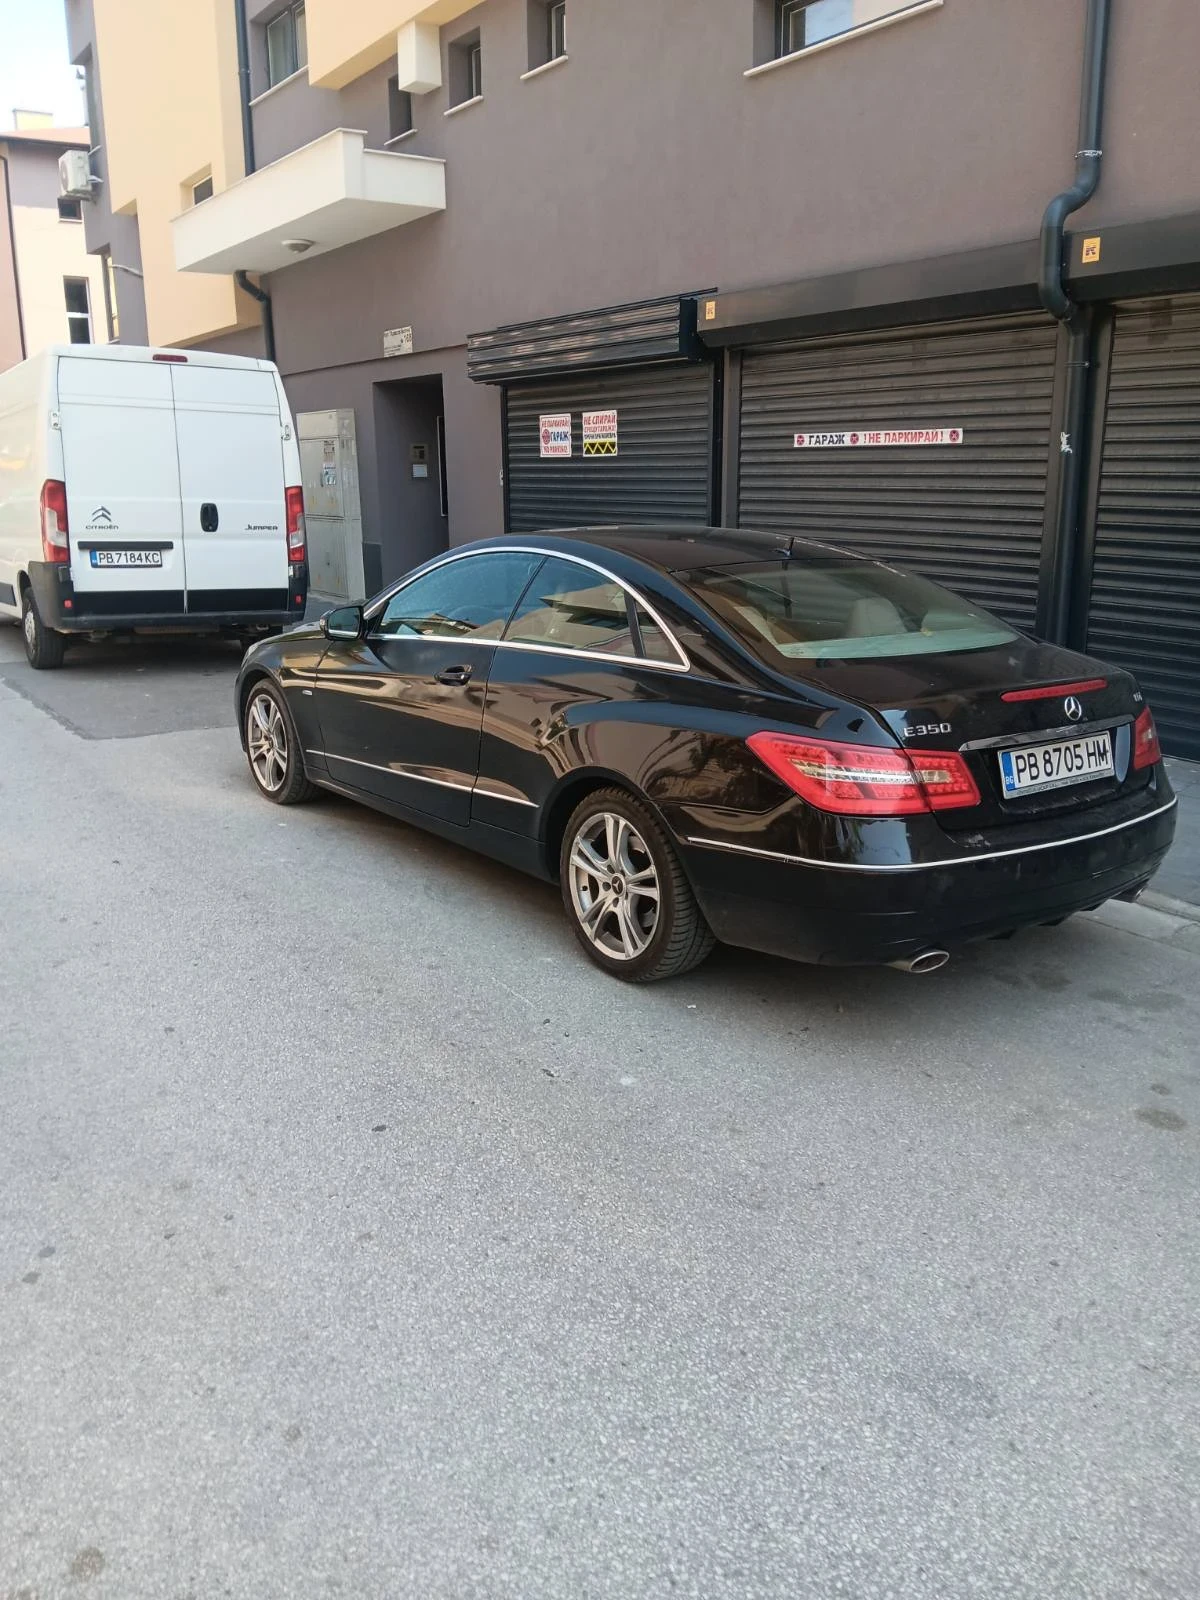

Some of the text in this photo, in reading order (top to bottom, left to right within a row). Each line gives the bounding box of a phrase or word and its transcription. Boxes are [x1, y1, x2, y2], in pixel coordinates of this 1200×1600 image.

[584, 414, 616, 425] НЕ СПИРАЙ
[550, 431, 568, 442] ГАРАЖ
[808, 434, 845, 445] ГАРАЖ
[884, 430, 944, 443] ПАРКИРАЙ!
[98, 552, 160, 564] PB 7184 KC
[903, 722, 951, 738] E350
[1014, 752, 1040, 784] PB
[1042, 743, 1084, 777] 8705
[1085, 738, 1109, 769] HM
[1005, 775, 1014, 785] BG
